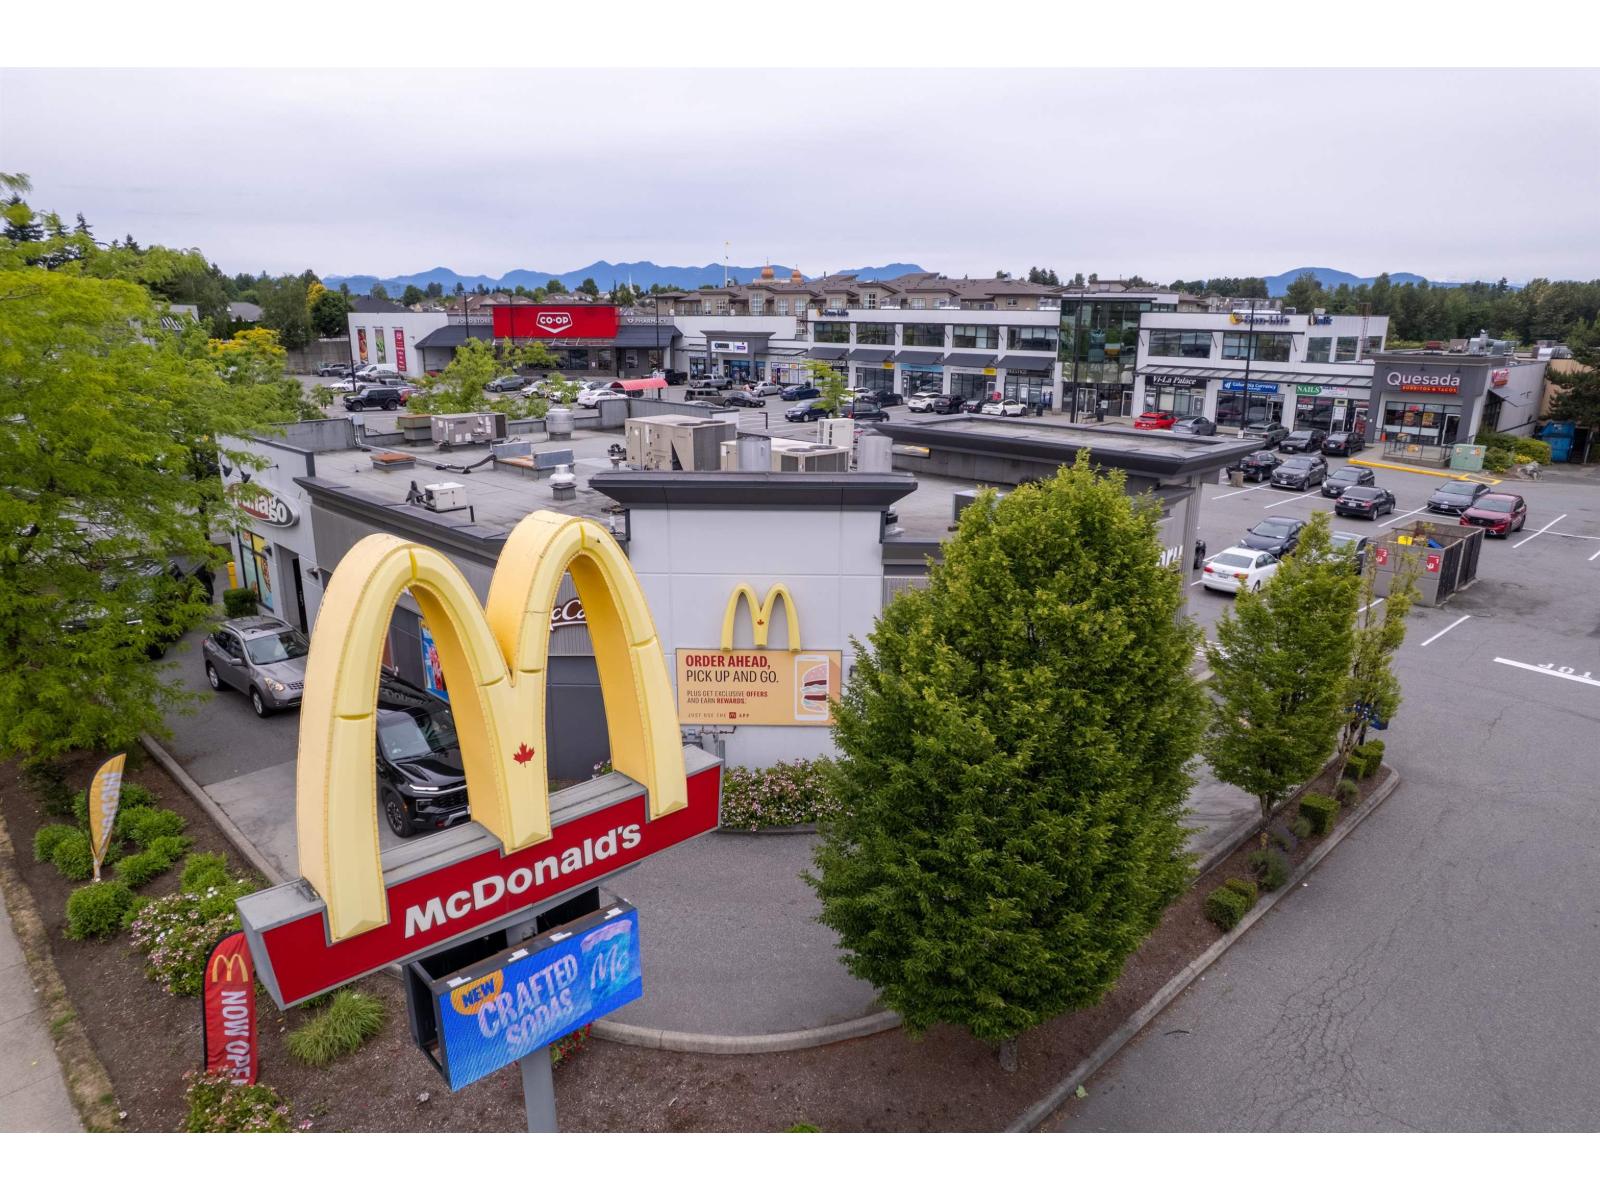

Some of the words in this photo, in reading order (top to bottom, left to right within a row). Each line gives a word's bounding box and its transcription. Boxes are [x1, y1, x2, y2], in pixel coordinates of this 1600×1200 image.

[1152, 375, 1172, 384] Vi-La
[1173, 376, 1197, 385] Palace
[1297, 385, 1320, 393] NAILS
[1386, 371, 1460, 386] Quesada
[685, 654, 725, 667] ORDER
[727, 655, 771, 670] AHEAD,
[686, 670, 713, 682] PICK
[715, 670, 730, 683] UP
[733, 670, 757, 683] AND
[760, 670, 779, 683] GO.
[404, 824, 642, 939] McDonald's
[461, 977, 496, 1008] NEW
[478, 953, 578, 1038] CRAFTED
[220, 990, 249, 1037] NOW
[506, 987, 575, 1046] SODAS
